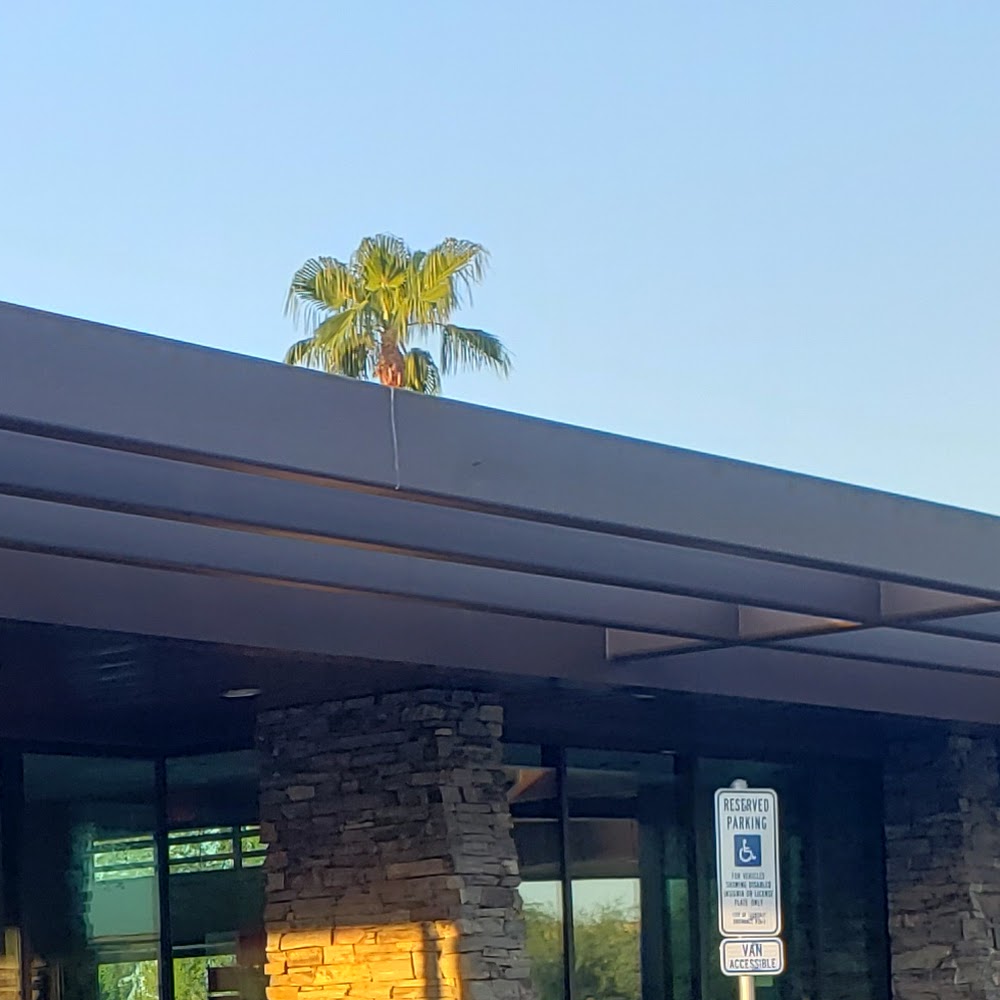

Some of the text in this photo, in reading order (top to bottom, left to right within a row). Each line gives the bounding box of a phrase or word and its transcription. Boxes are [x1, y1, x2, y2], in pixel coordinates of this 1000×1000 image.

[723, 798, 770, 813] RESERVED
[726, 816, 768, 830] PARKING
[742, 943, 763, 957] VAN
[729, 957, 776, 969] ACCESSIBLE
